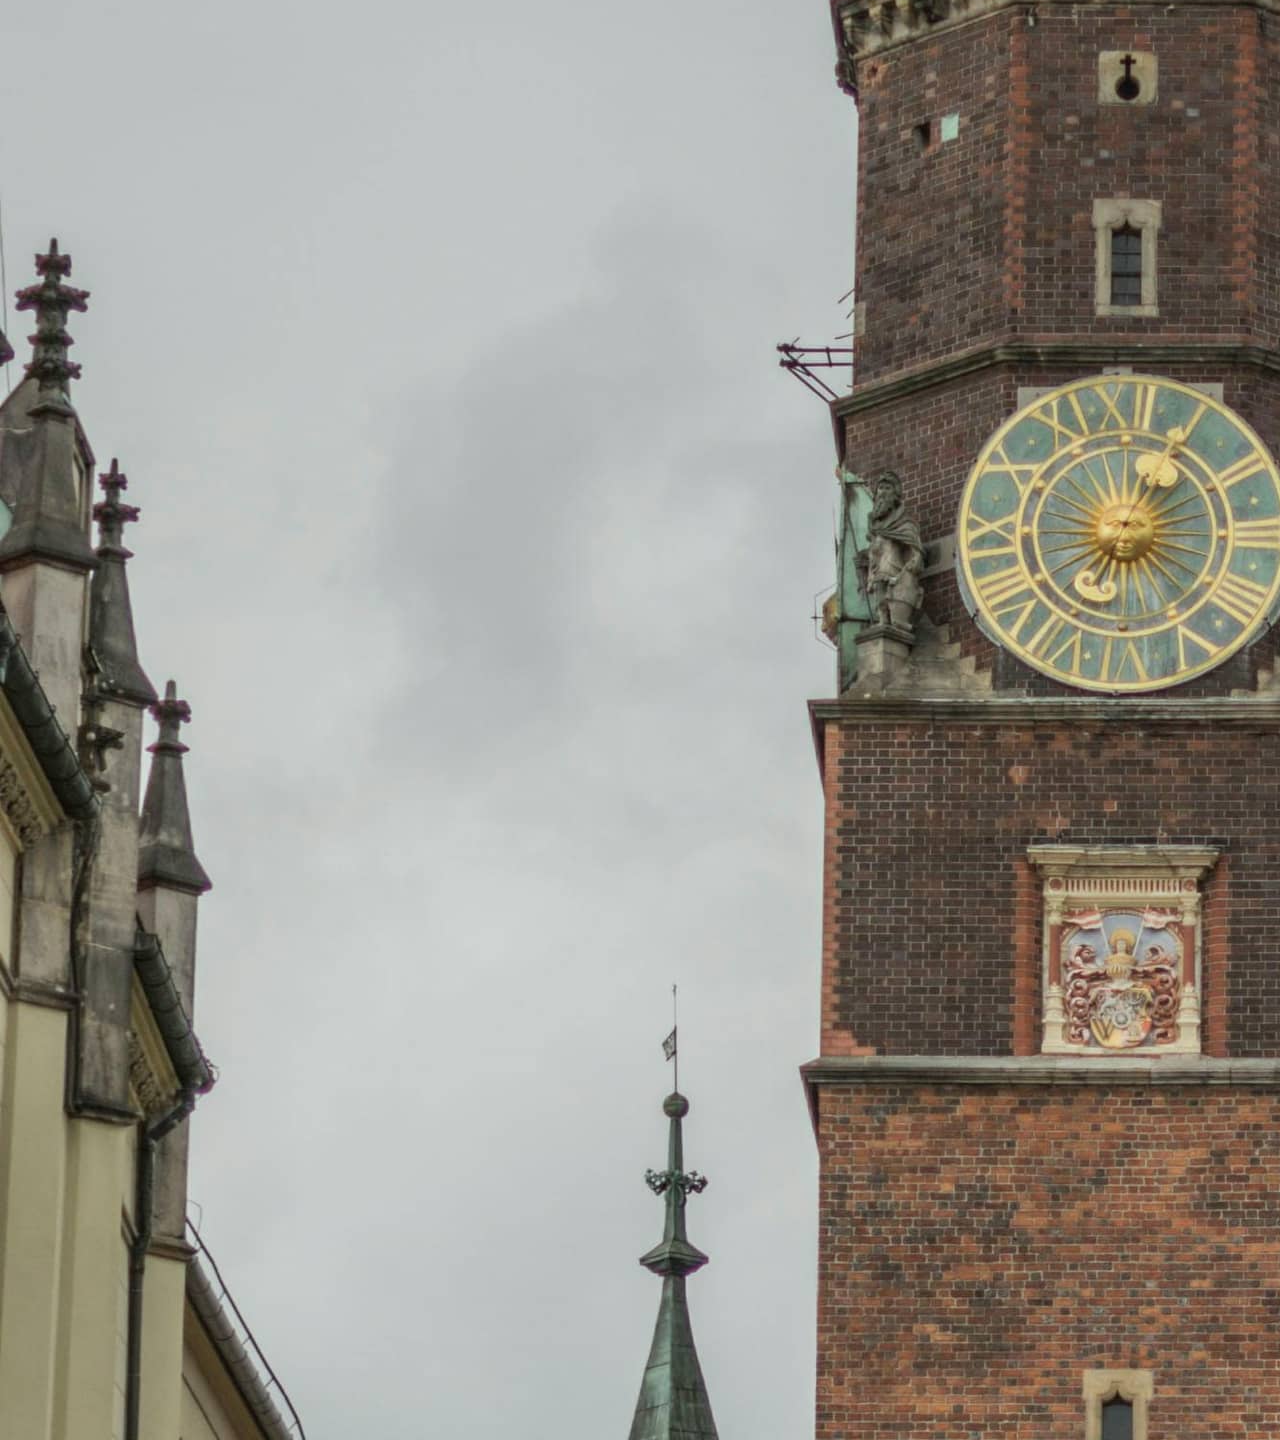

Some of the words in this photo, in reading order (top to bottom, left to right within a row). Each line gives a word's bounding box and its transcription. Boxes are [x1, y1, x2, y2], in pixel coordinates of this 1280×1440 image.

[1030, 391, 1090, 450] XI
[1093, 382, 1157, 431] XII
[979, 439, 1043, 498] X
[1217, 451, 1267, 487] II
[968, 510, 1017, 559] IX
[974, 565, 1039, 641] VIII
[1026, 613, 1083, 674] VII
[1100, 637, 1149, 681] VI
[1177, 624, 1225, 671] V
